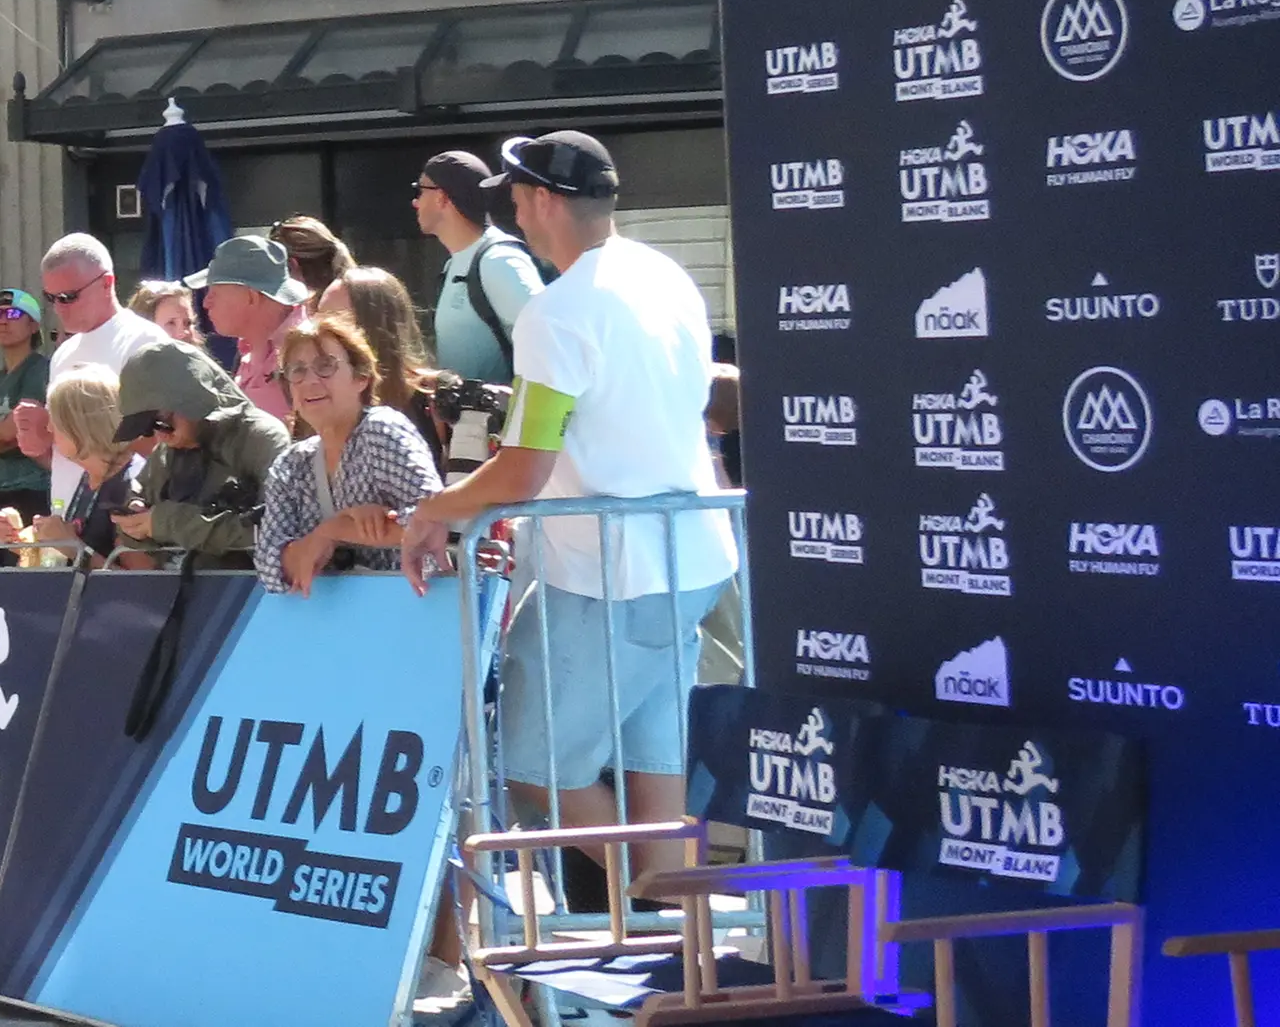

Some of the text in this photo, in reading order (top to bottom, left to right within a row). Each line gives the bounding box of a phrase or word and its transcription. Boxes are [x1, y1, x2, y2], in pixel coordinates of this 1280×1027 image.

[893, 24, 937, 46] HOKA
[765, 42, 838, 75] UTMB
[893, 39, 982, 79] UTMB
[900, 146, 942, 166] HOKA
[1047, 129, 1136, 167] HOKA
[771, 159, 842, 190] UTMB
[900, 163, 988, 200] UTMB
[1047, 167, 1136, 186] FLY HUMAN FLY
[778, 284, 851, 314] HOKA
[1046, 292, 1160, 321] SUUNTO
[923, 307, 980, 330] näak
[783, 395, 855, 423] UTMB
[912, 394, 956, 410] HOKA
[1235, 398, 1263, 419] La
[912, 413, 1002, 445] UTMB
[788, 511, 862, 542] UTMB
[919, 515, 962, 533] HOKA
[1069, 523, 1159, 556] HOKA
[919, 534, 1009, 569] UTMB
[1229, 526, 1280, 558] UT
[1069, 560, 1160, 576] FLY HUMAN FLY
[797, 629, 869, 664] HOKA
[943, 671, 1002, 699] näak
[1068, 677, 1185, 710] SUUNTO
[749, 728, 792, 754] HOKA
[190, 716, 425, 836] UTMB
[749, 752, 836, 804] UTMB
[937, 765, 1002, 794] HOKA
[939, 791, 1064, 846] UTMB
[182, 836, 390, 915] WORLD SERIES
